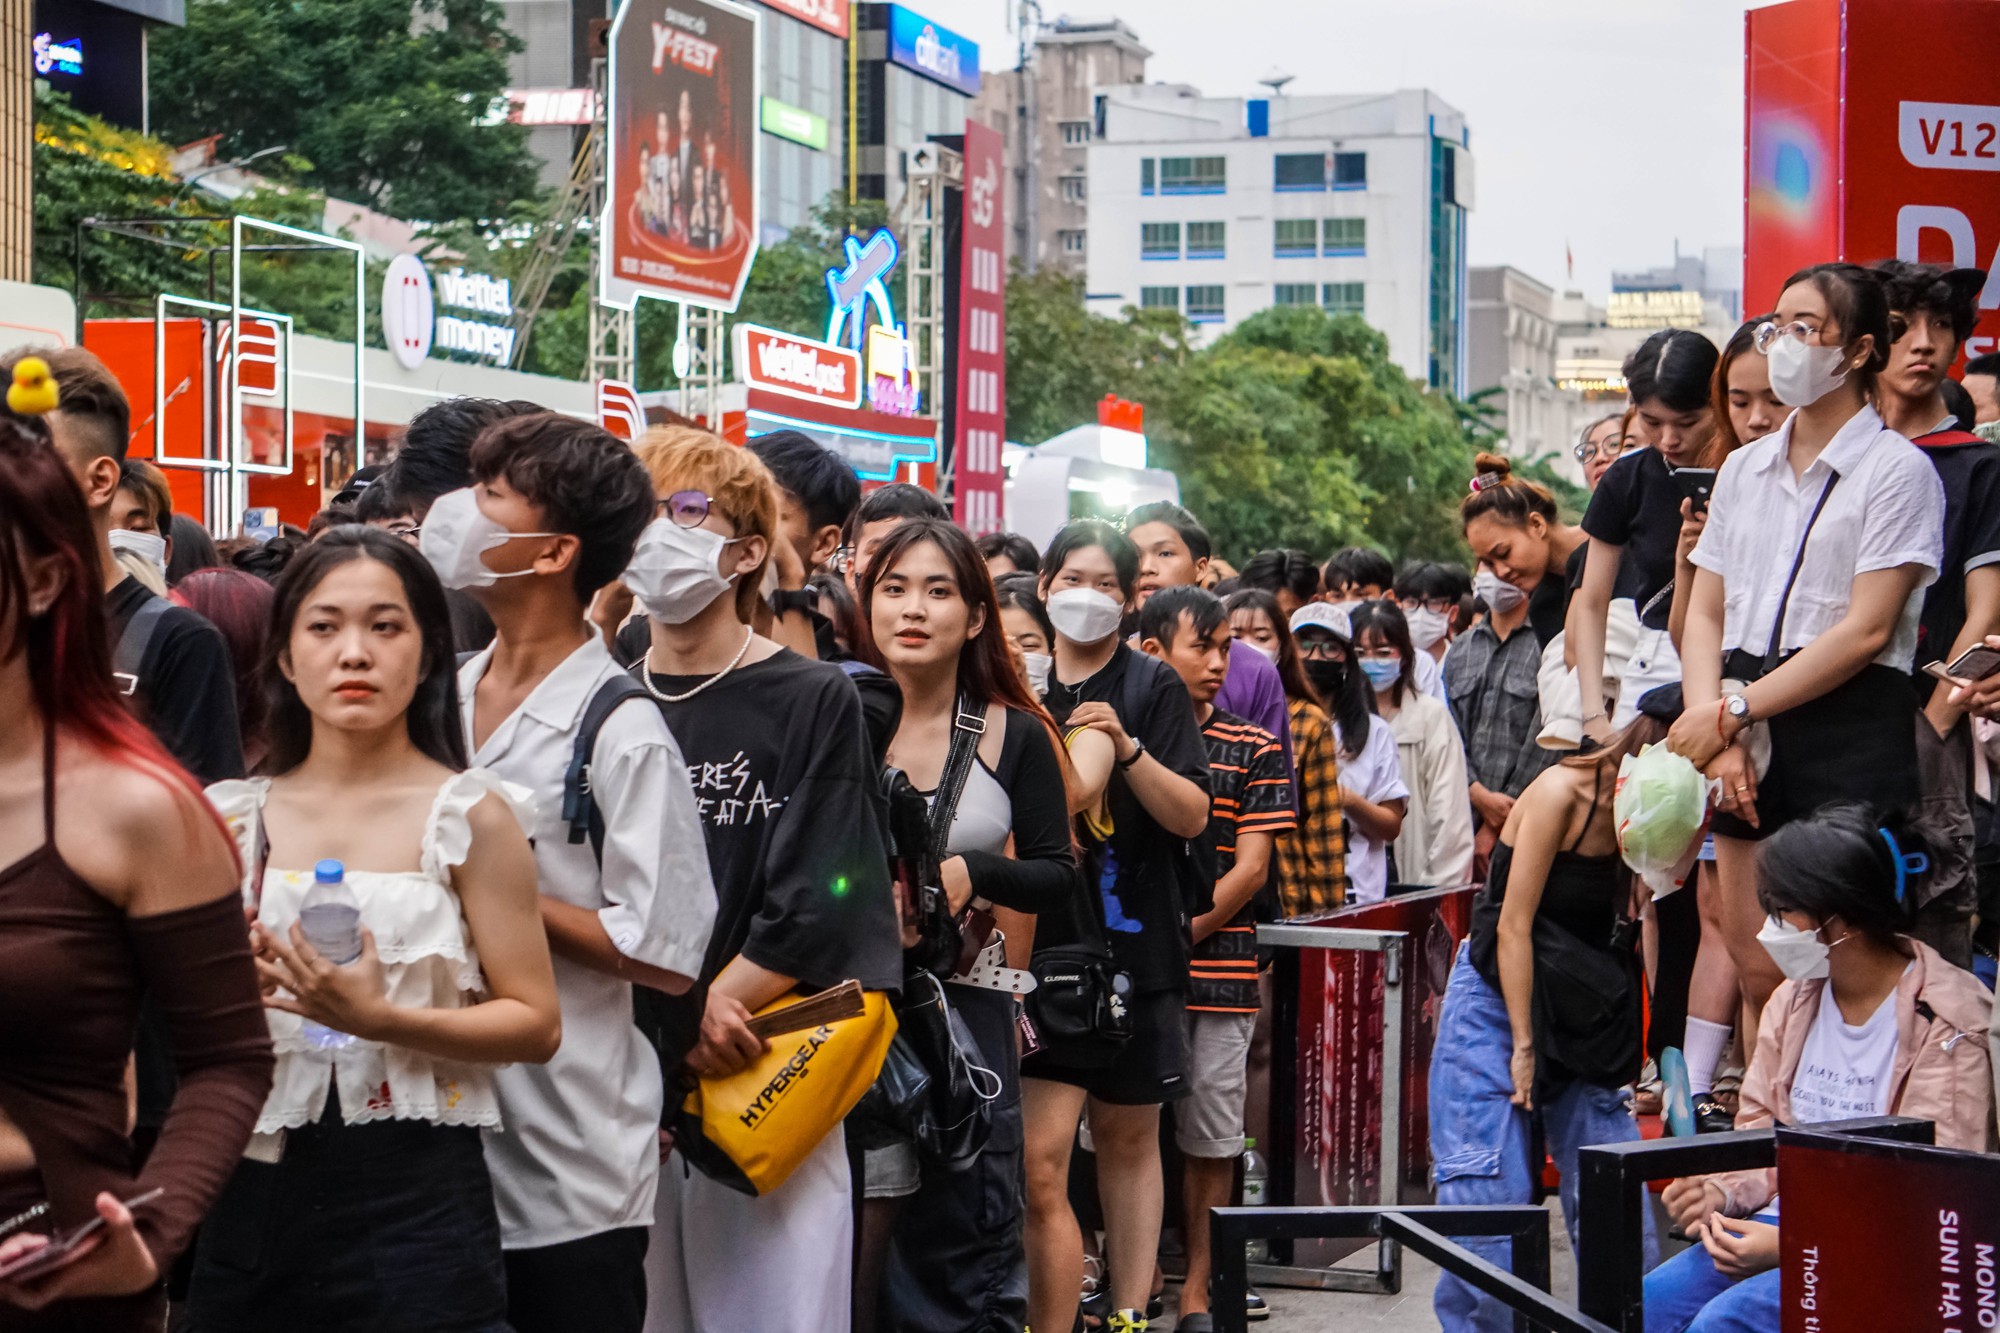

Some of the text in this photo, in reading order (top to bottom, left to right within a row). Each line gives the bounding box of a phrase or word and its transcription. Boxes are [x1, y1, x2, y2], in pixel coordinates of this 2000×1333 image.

[436, 315, 515, 367] money
[687, 750, 750, 796] ERE'S
[713, 798, 746, 826] AT
[1352, 949, 1361, 1006] ZON
[739, 1024, 835, 1128] HYPERGEAR
[1938, 1208, 1960, 1274] SUNI
[1801, 1246, 1821, 1333] Thông ti
[1937, 1281, 1962, 1320] HẠ
[1975, 1243, 1997, 1329] MONO
